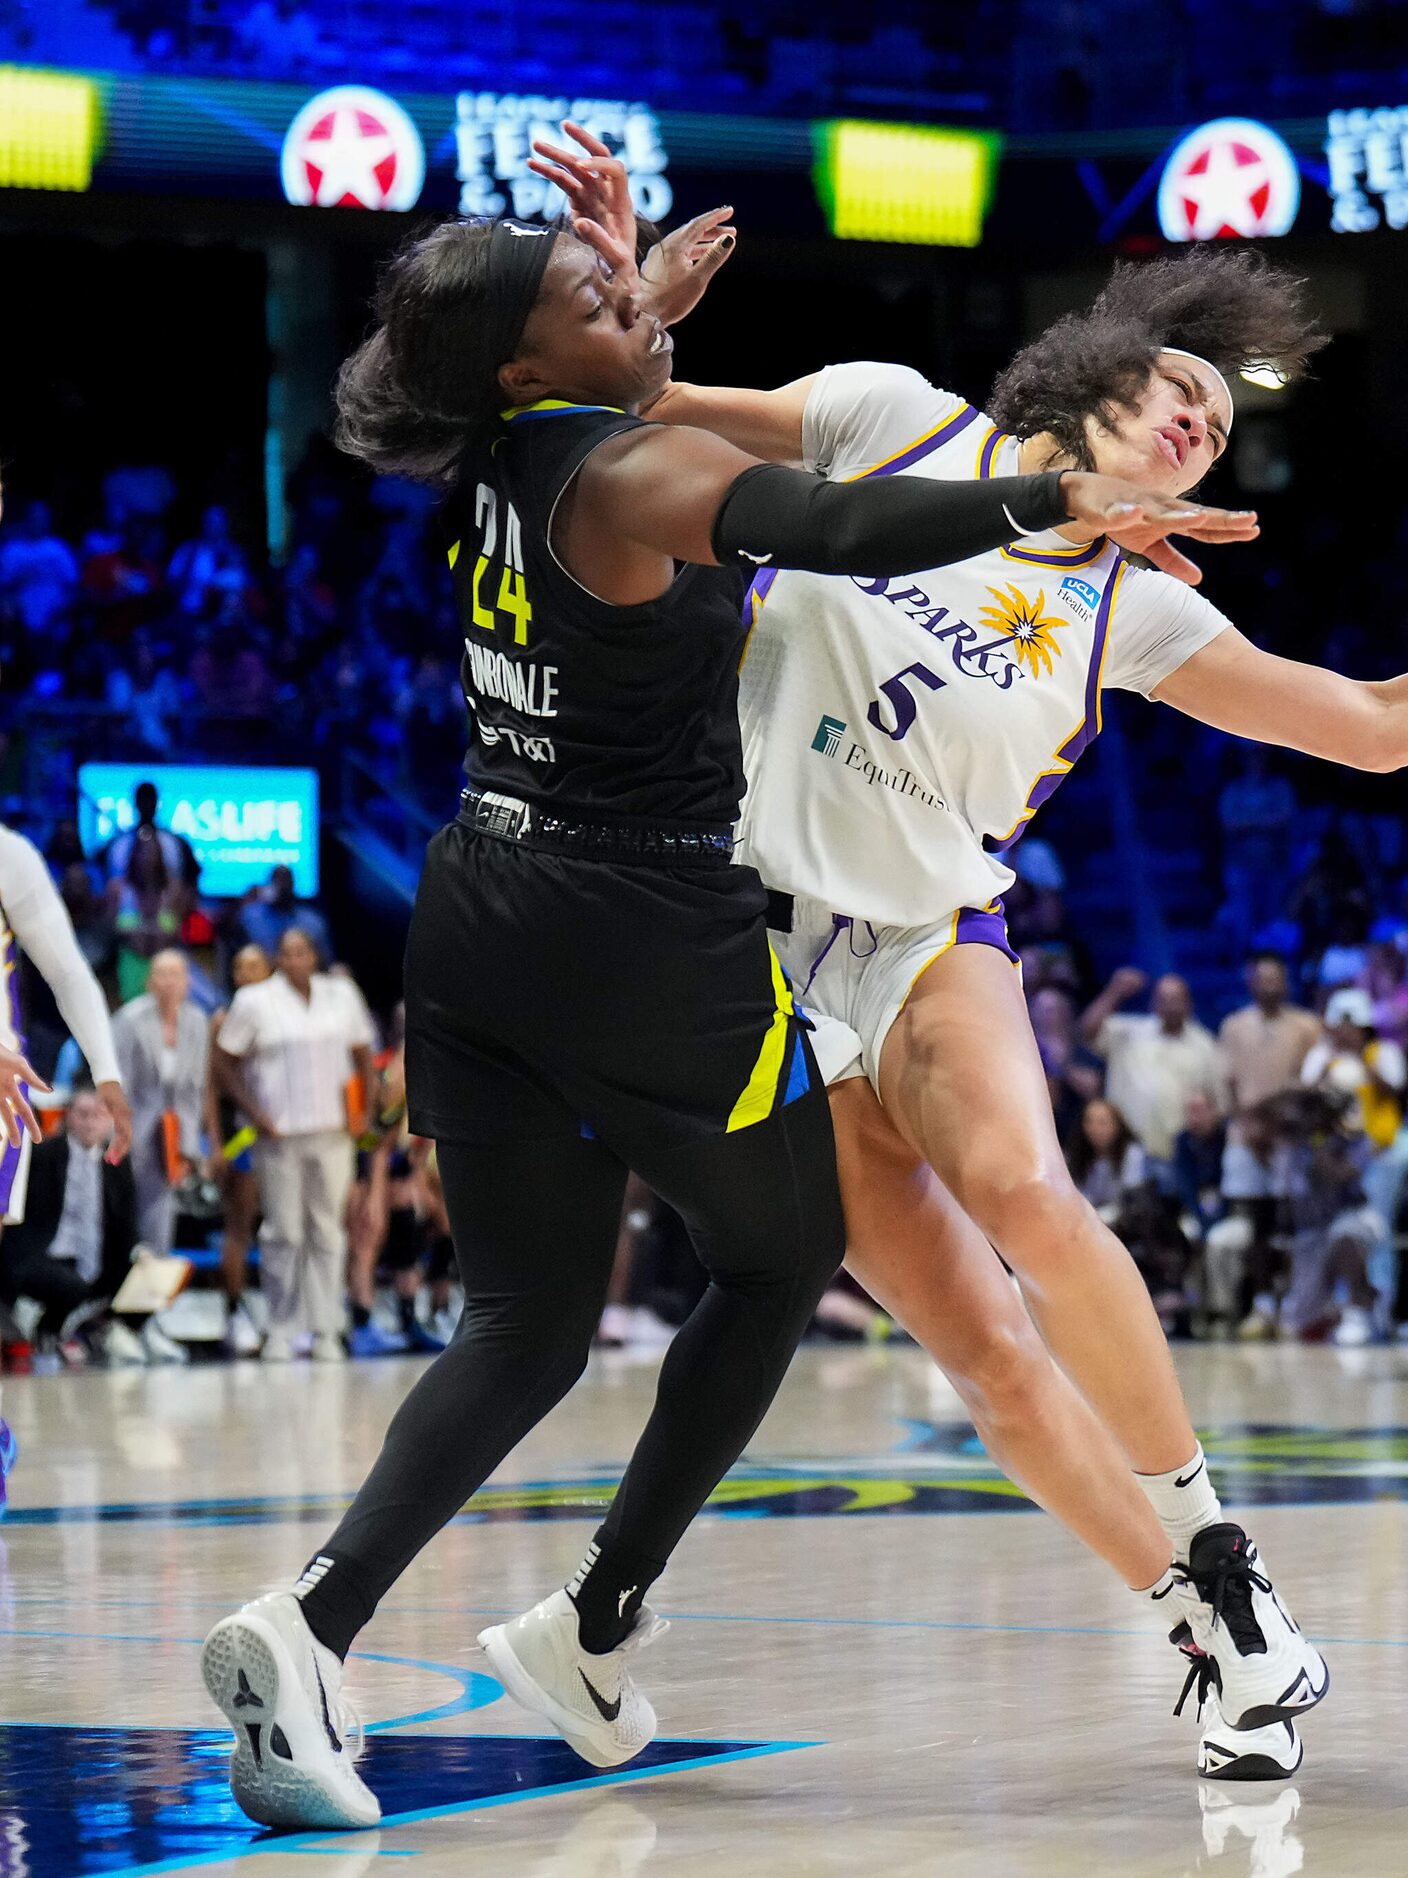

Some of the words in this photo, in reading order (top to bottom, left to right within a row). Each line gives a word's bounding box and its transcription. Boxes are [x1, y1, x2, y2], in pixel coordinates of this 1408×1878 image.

[472, 482, 532, 646] 24
[1066, 579, 1096, 604] UCLA
[1057, 588, 1089, 622] Health
[867, 661, 948, 741] 5
[844, 743, 951, 812] EquiTrus
